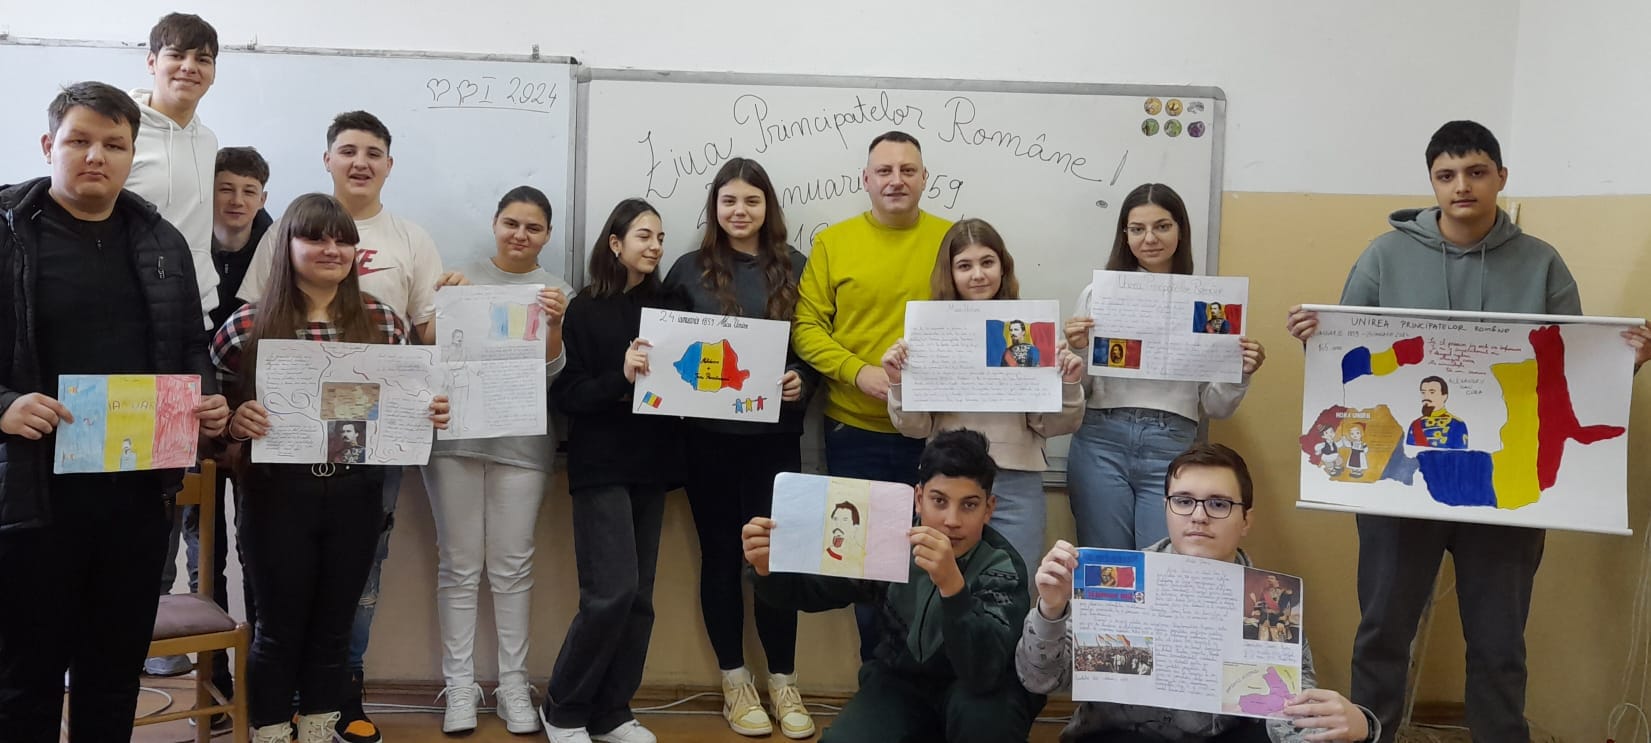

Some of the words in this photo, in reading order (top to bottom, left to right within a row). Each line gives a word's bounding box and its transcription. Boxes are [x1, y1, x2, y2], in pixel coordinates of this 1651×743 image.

[506, 76, 558, 108] 2024
[733, 94, 926, 154] Principatelor
[659, 310, 675, 323] 24
[1351, 317, 1390, 329] UNIREA
[1400, 320, 1467, 332] PRINCIPATELOR
